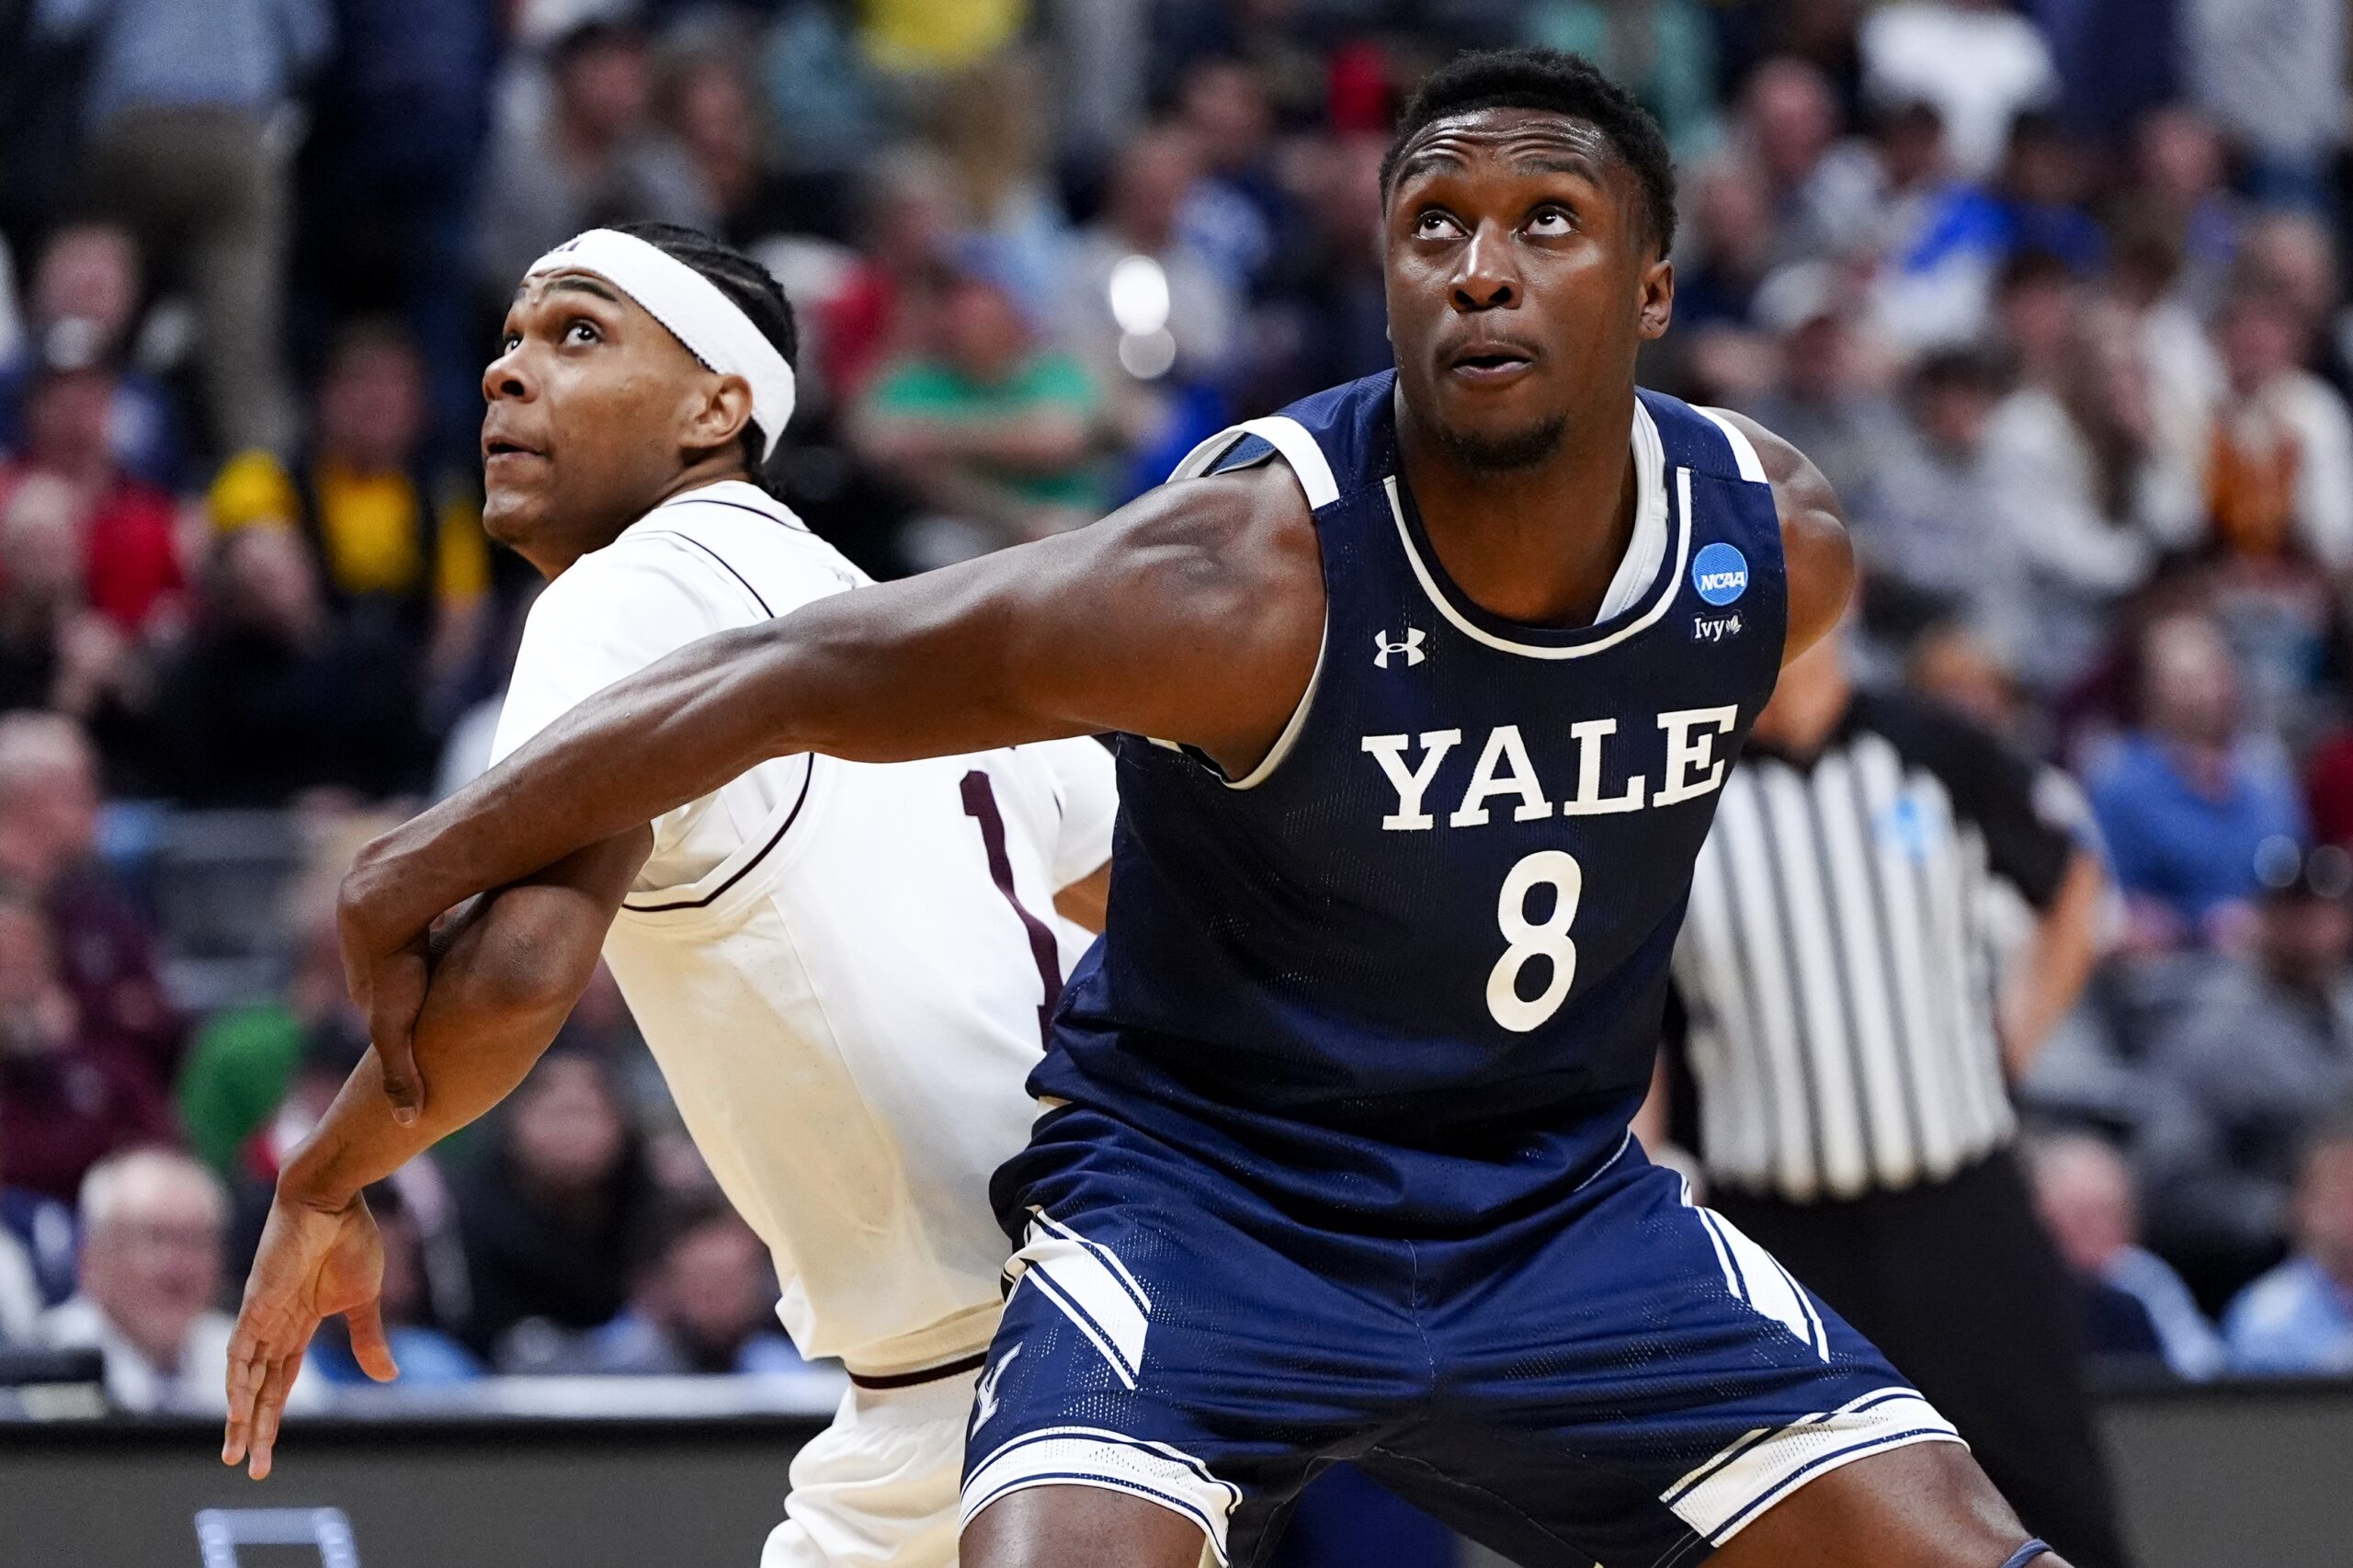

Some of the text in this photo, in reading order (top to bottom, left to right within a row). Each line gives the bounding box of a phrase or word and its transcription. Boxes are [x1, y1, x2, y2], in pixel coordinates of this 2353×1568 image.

[1694, 618, 1724, 642] Ivy
[1700, 572, 1745, 591] NCAA
[1361, 704, 1738, 830] YALE
[960, 769, 1064, 1051] 1
[1486, 850, 1582, 1032] 8
